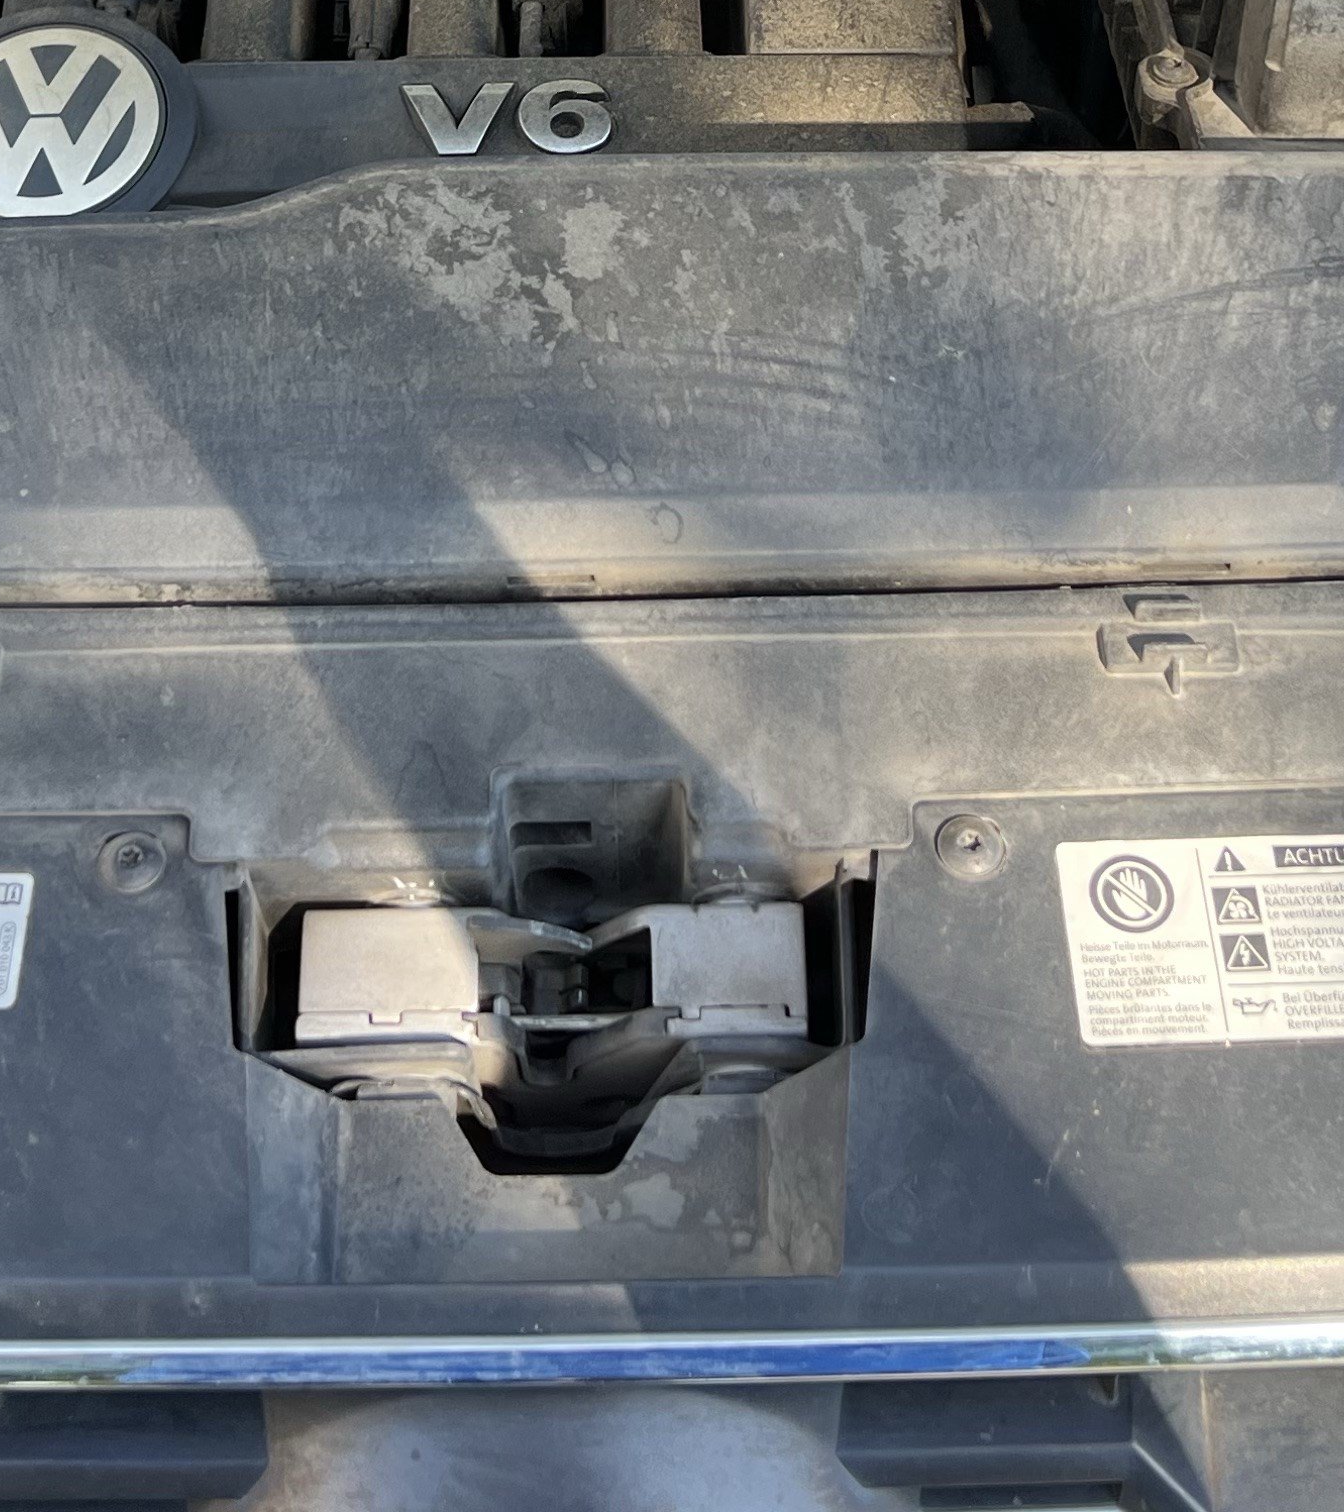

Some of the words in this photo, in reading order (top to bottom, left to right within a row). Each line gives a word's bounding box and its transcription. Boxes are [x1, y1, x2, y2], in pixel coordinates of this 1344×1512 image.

[399, 78, 615, 156] V6
[1264, 895, 1324, 908] RADIATOR
[1273, 938, 1307, 950] HIGH
